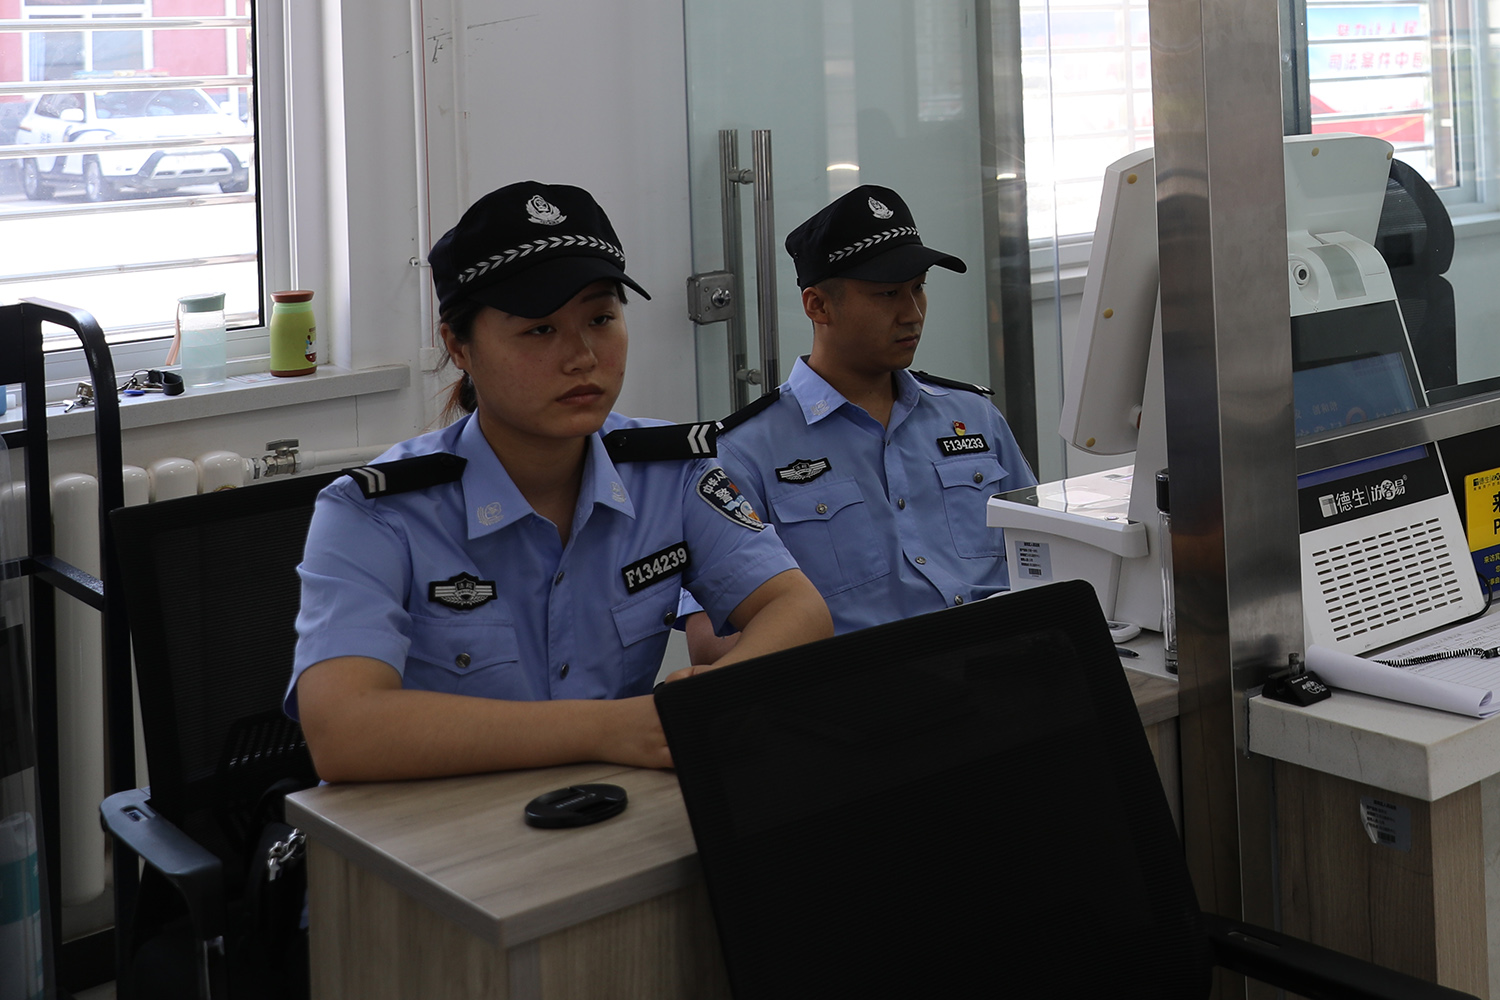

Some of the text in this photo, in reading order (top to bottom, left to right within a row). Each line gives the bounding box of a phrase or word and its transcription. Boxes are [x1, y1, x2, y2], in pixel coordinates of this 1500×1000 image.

[943, 437, 985, 452] F134233
[714, 487, 733, 504] 警
[1335, 487, 1368, 514] 德生
[626, 547, 688, 589] F134239
